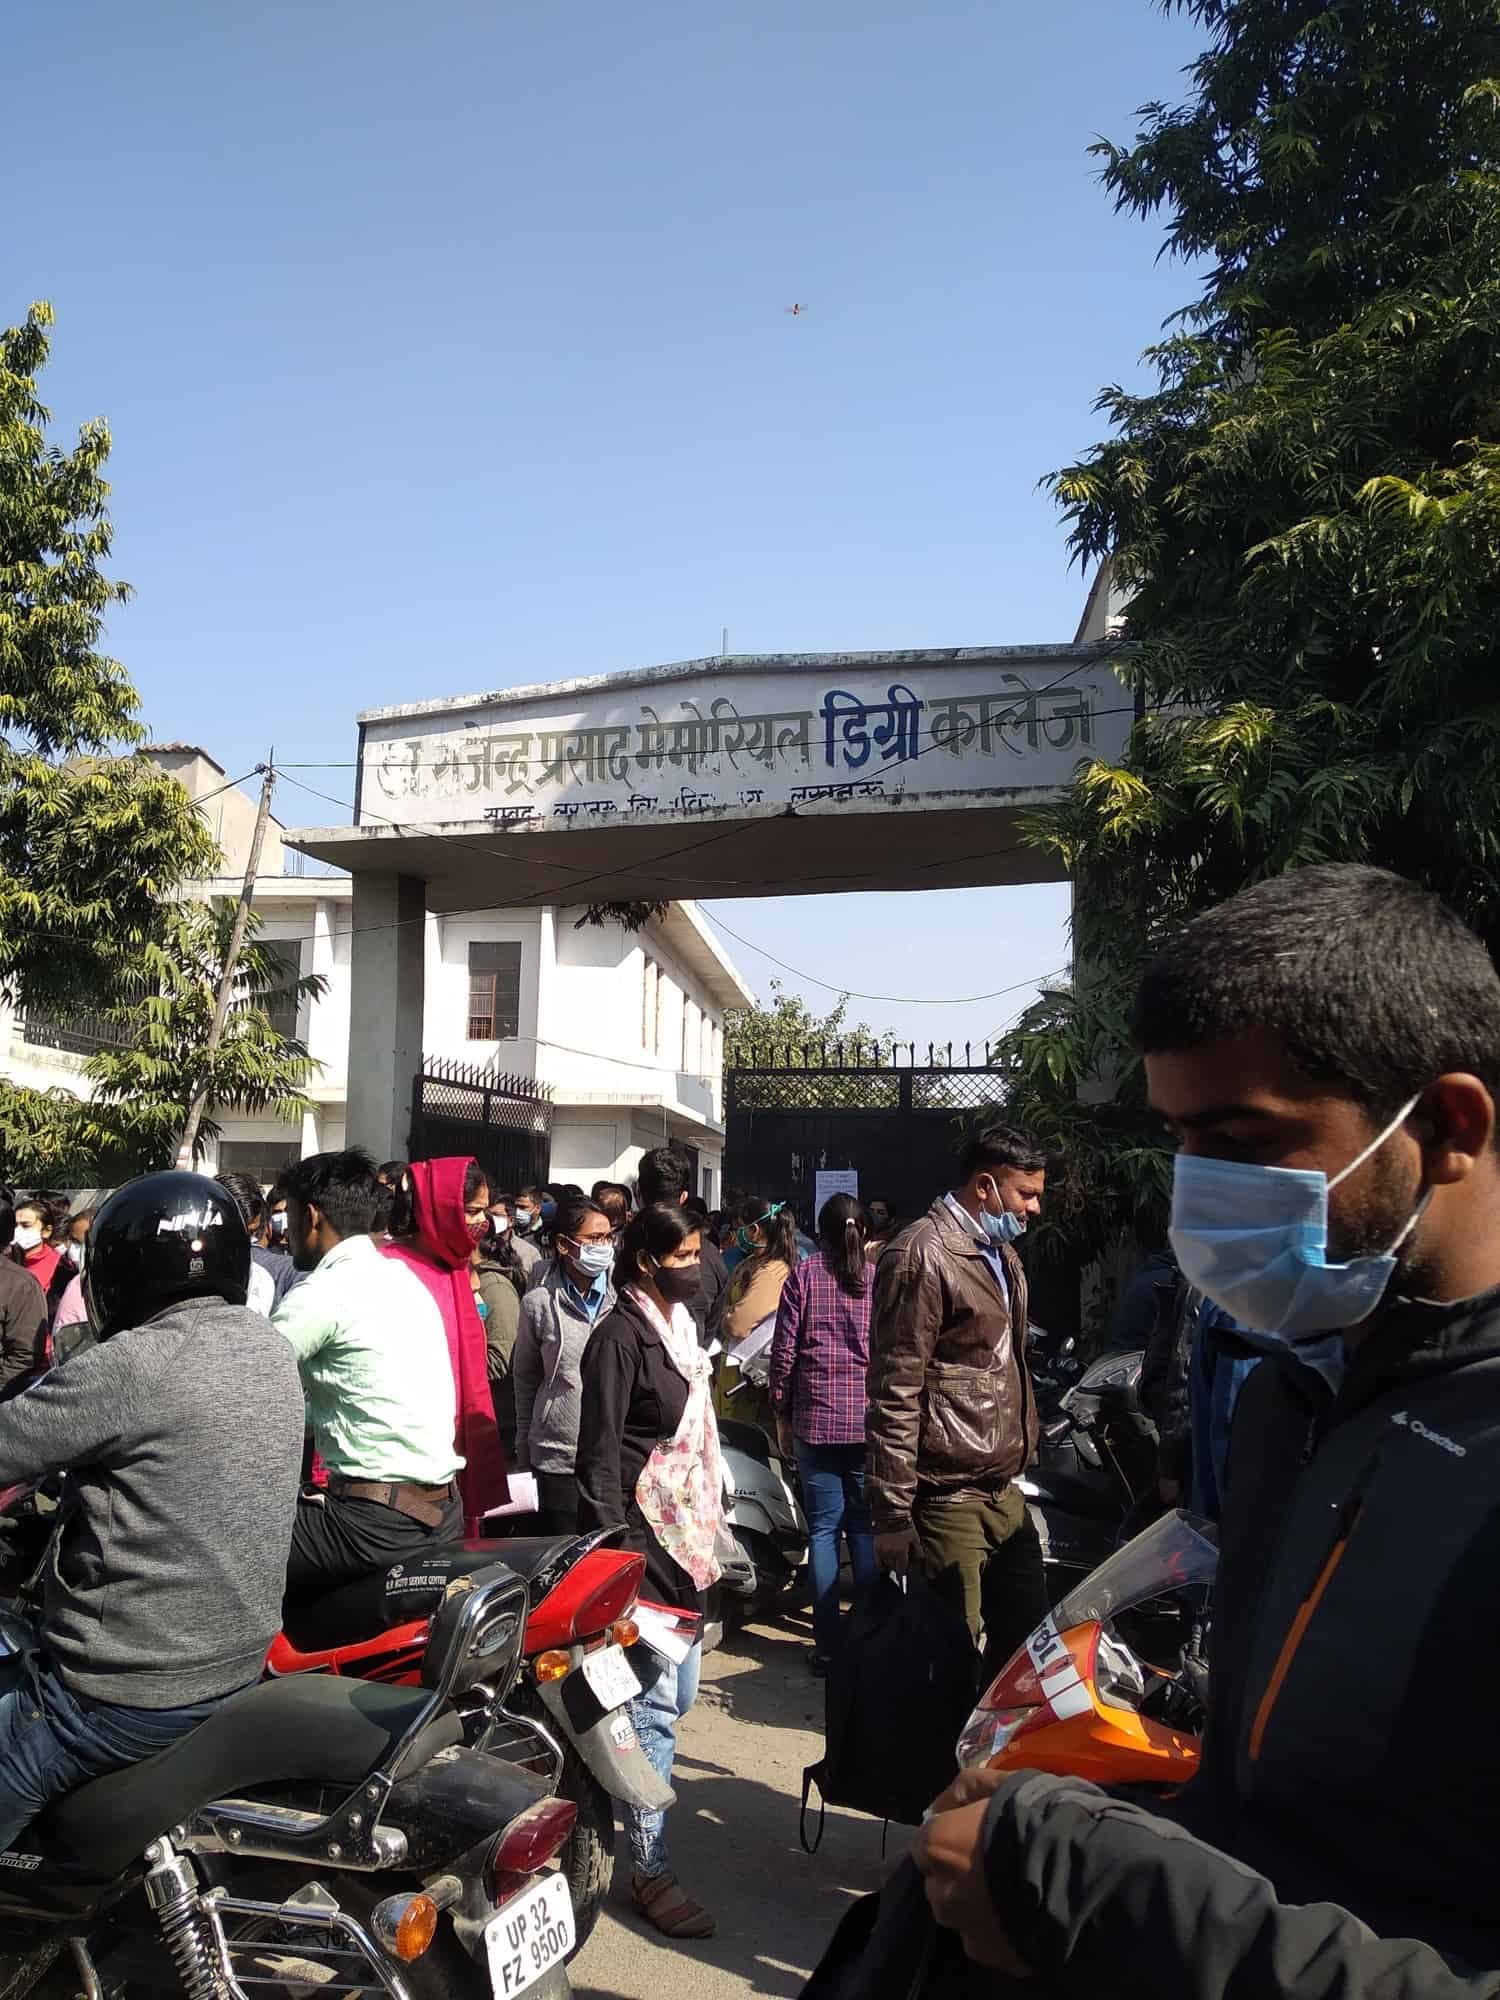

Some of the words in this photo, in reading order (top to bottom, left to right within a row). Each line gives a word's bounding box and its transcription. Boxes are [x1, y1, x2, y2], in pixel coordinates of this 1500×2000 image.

[535, 725, 634, 790] प्रसाद
[819, 684, 923, 768] डिग्री
[157, 1210, 223, 1235] NINJA
[506, 1914, 527, 1951] UP
[530, 1897, 552, 1932] 32
[501, 1953, 526, 1994] FZ
[530, 1920, 568, 1970] 9500
